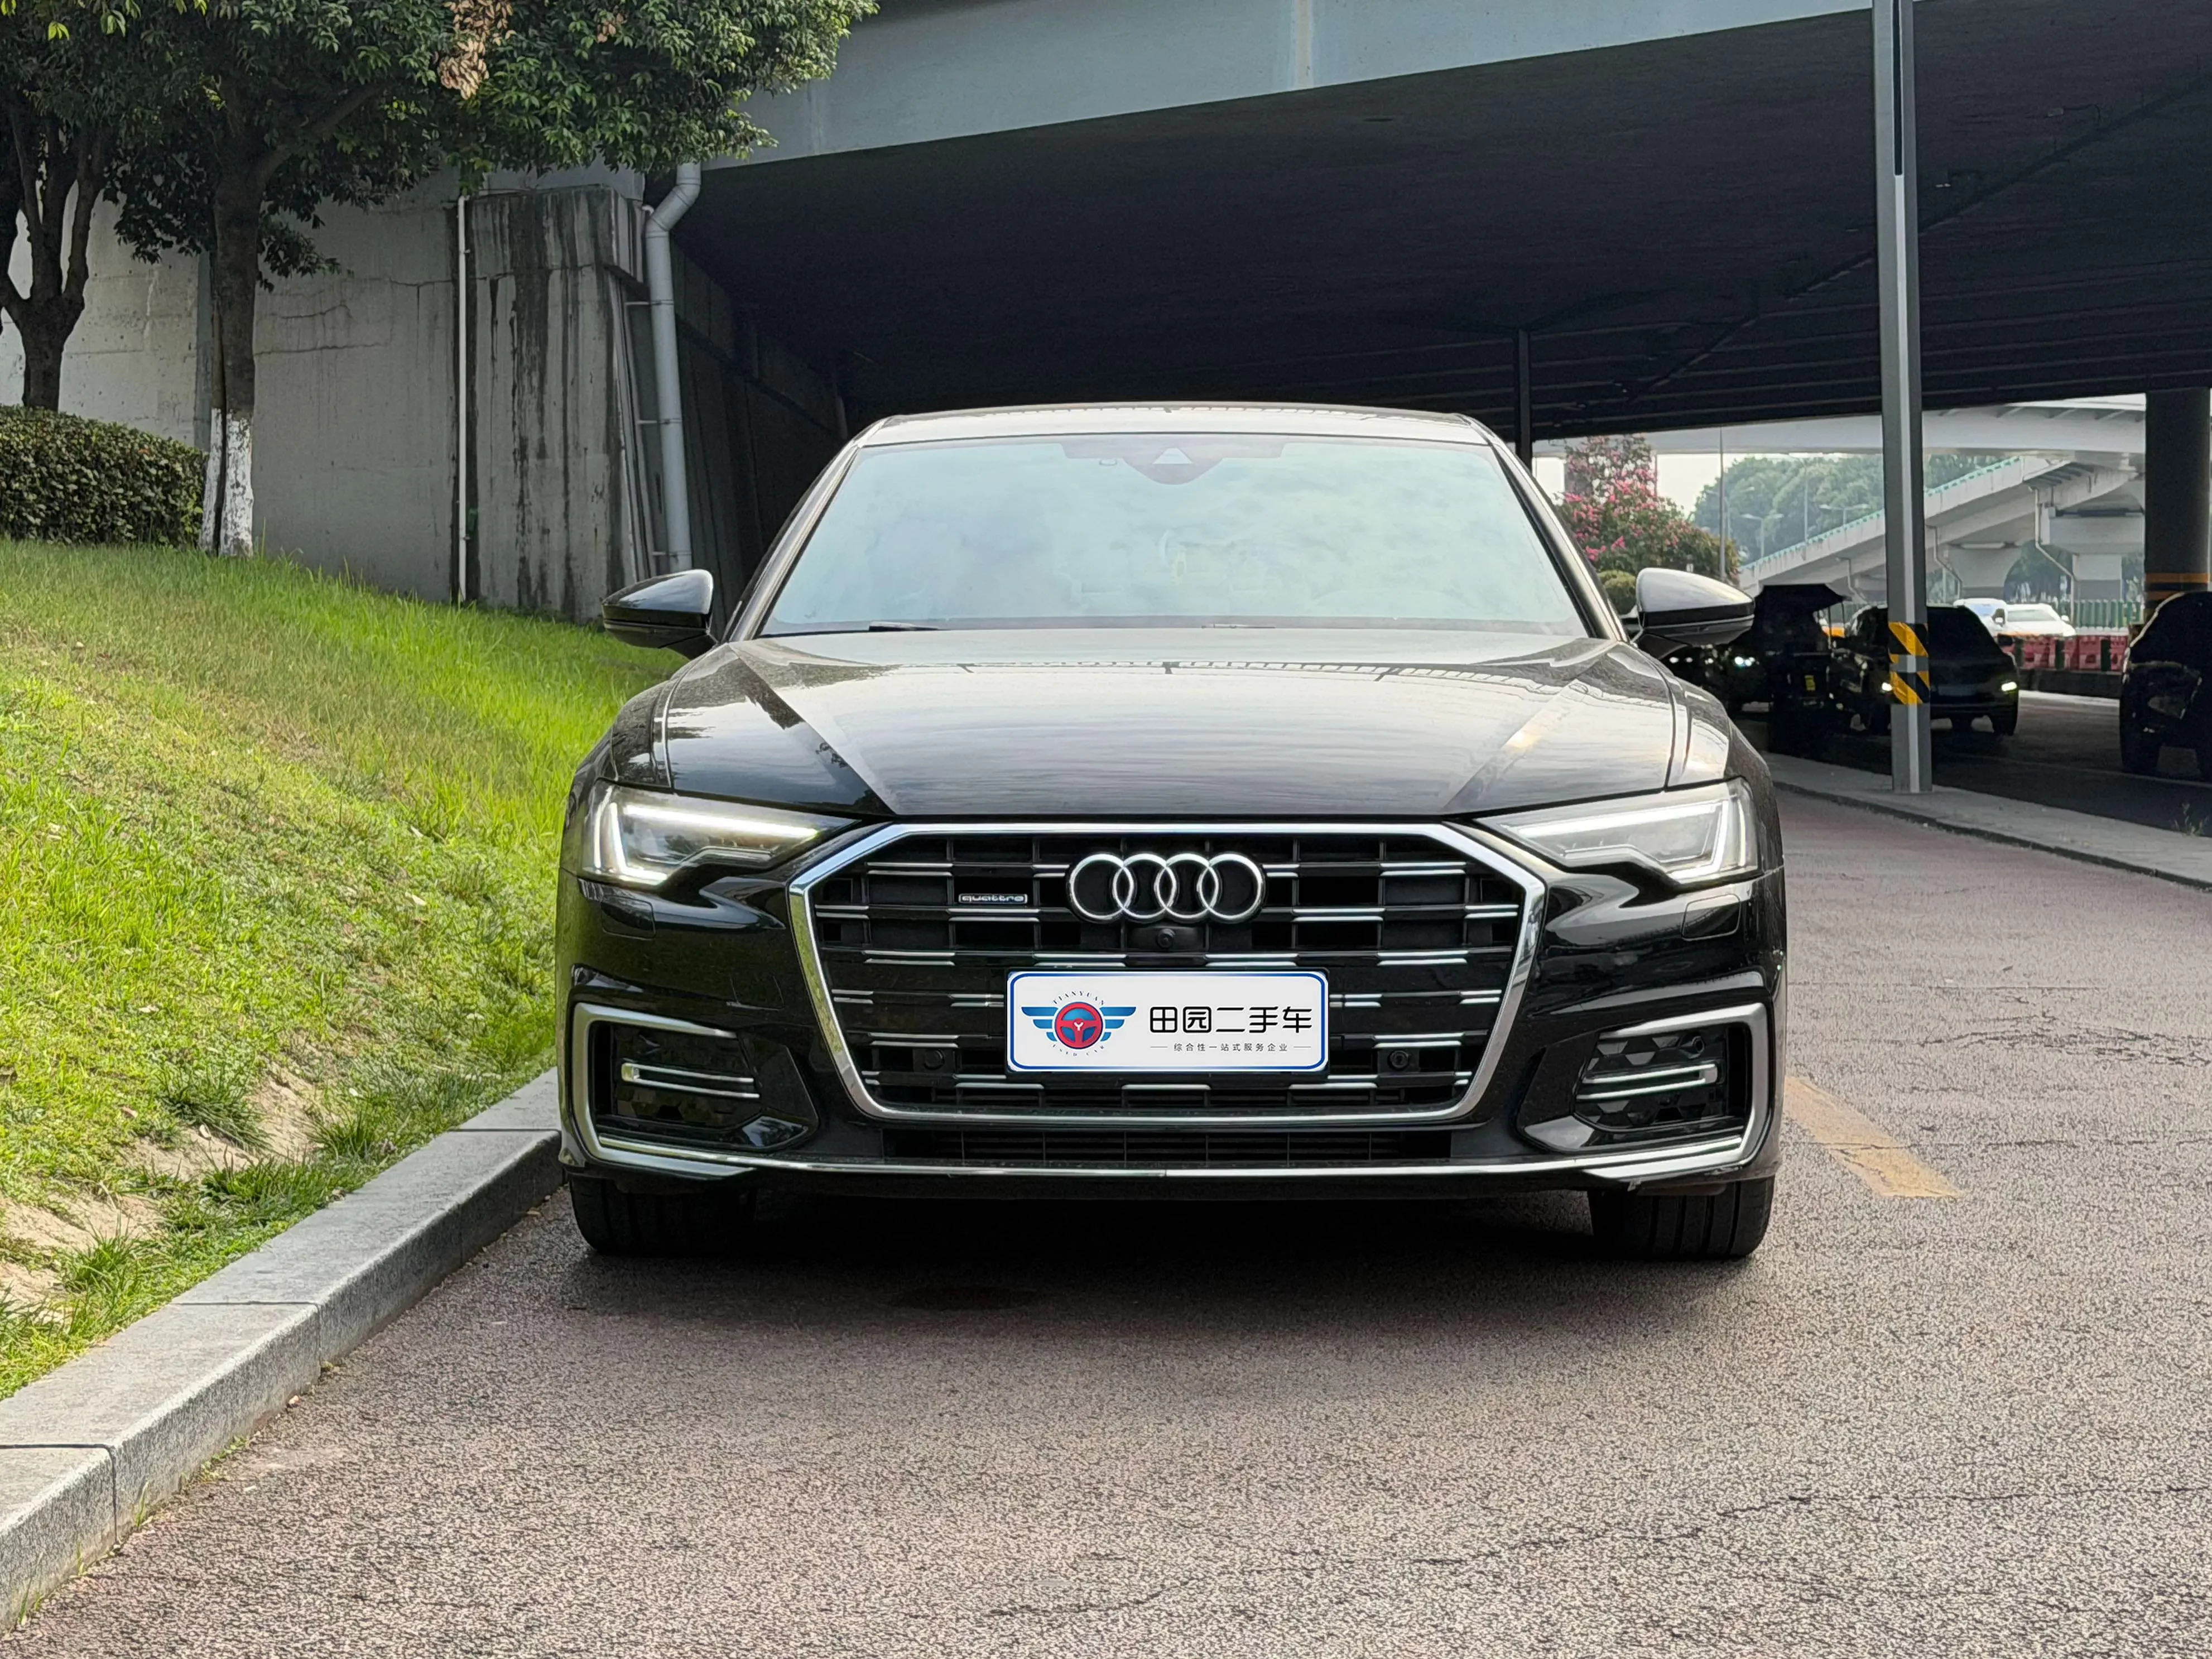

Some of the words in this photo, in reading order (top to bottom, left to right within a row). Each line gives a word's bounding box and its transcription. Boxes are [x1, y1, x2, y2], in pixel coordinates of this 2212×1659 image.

[961, 894, 1024, 902] quattro
[1150, 1006, 1312, 1033] 田园二手车
[1174, 1042, 1287, 1052] 综合性一站式服务企业
